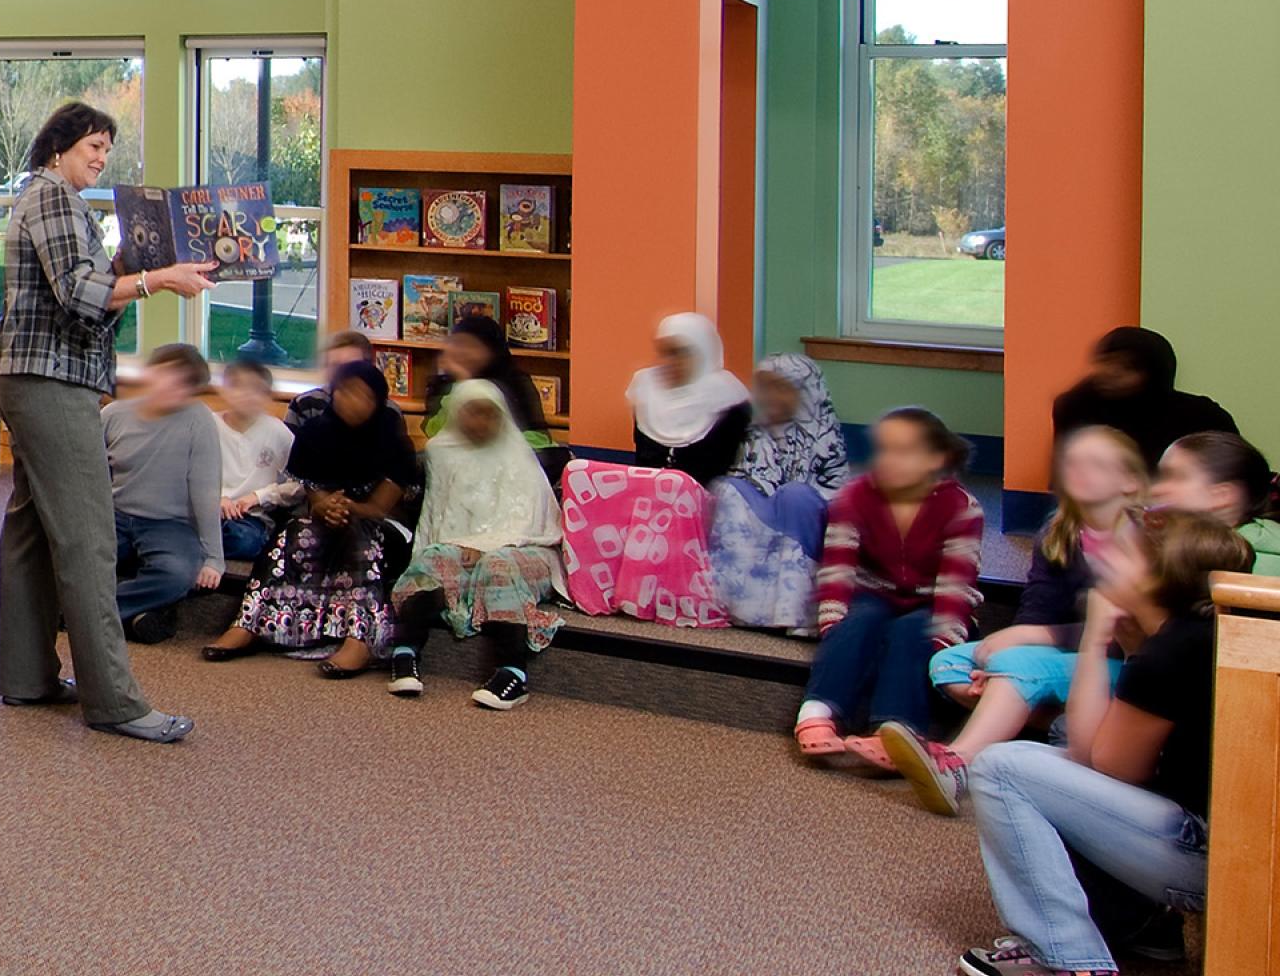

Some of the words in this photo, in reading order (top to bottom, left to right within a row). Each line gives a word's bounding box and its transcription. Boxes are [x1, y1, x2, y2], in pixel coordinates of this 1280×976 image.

[181, 188, 212, 205] CARL
[217, 183, 266, 202] REINER
[375, 192, 408, 204] Secret
